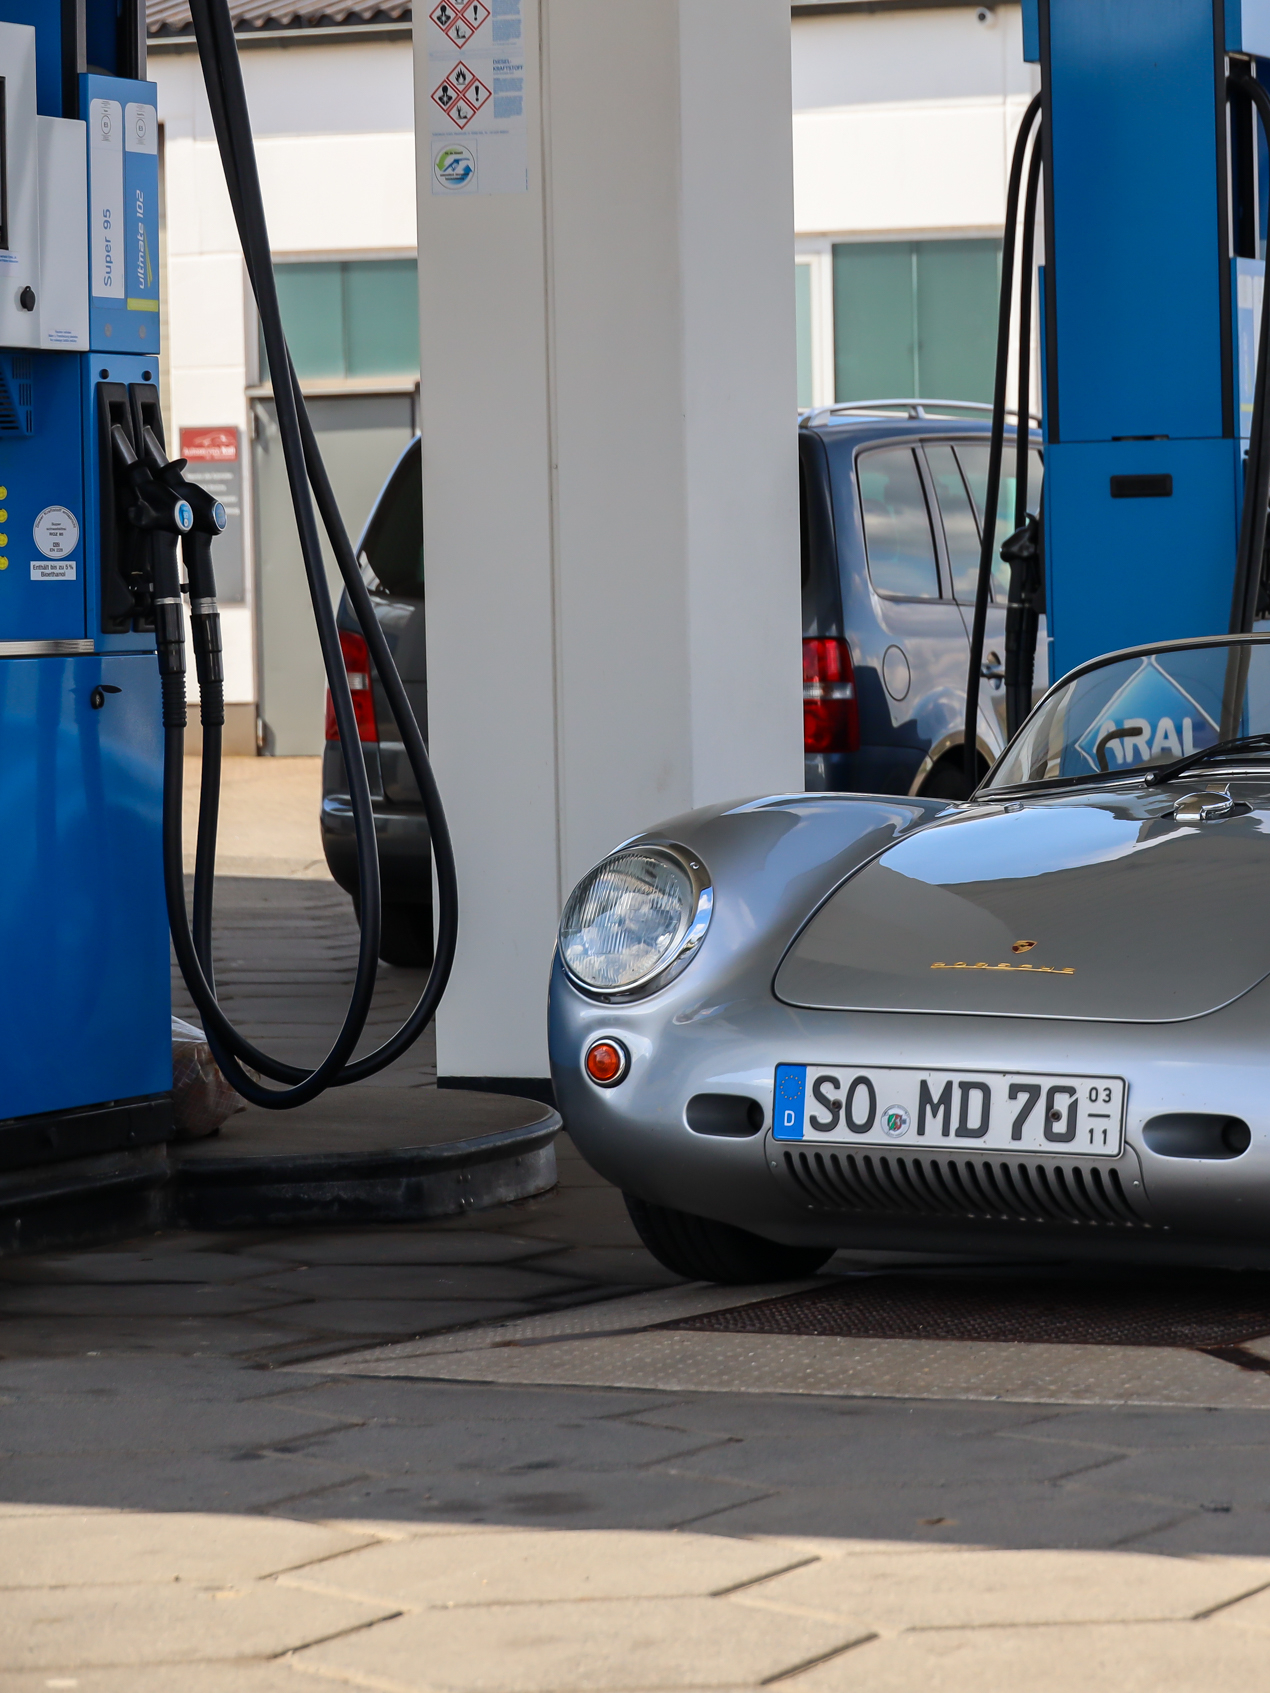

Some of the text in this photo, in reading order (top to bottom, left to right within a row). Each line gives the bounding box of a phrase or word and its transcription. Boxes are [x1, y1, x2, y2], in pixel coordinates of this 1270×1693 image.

[102, 208, 113, 288] 95 Super
[135, 190, 146, 289] 102 ultimate
[809, 1075, 878, 1134] SO
[916, 1079, 992, 1138] MD
[1008, 1083, 1079, 1142] 70
[1088, 1087, 1112, 1104] 03
[784, 1110, 795, 1127] D
[1088, 1128, 1108, 1146] 11
